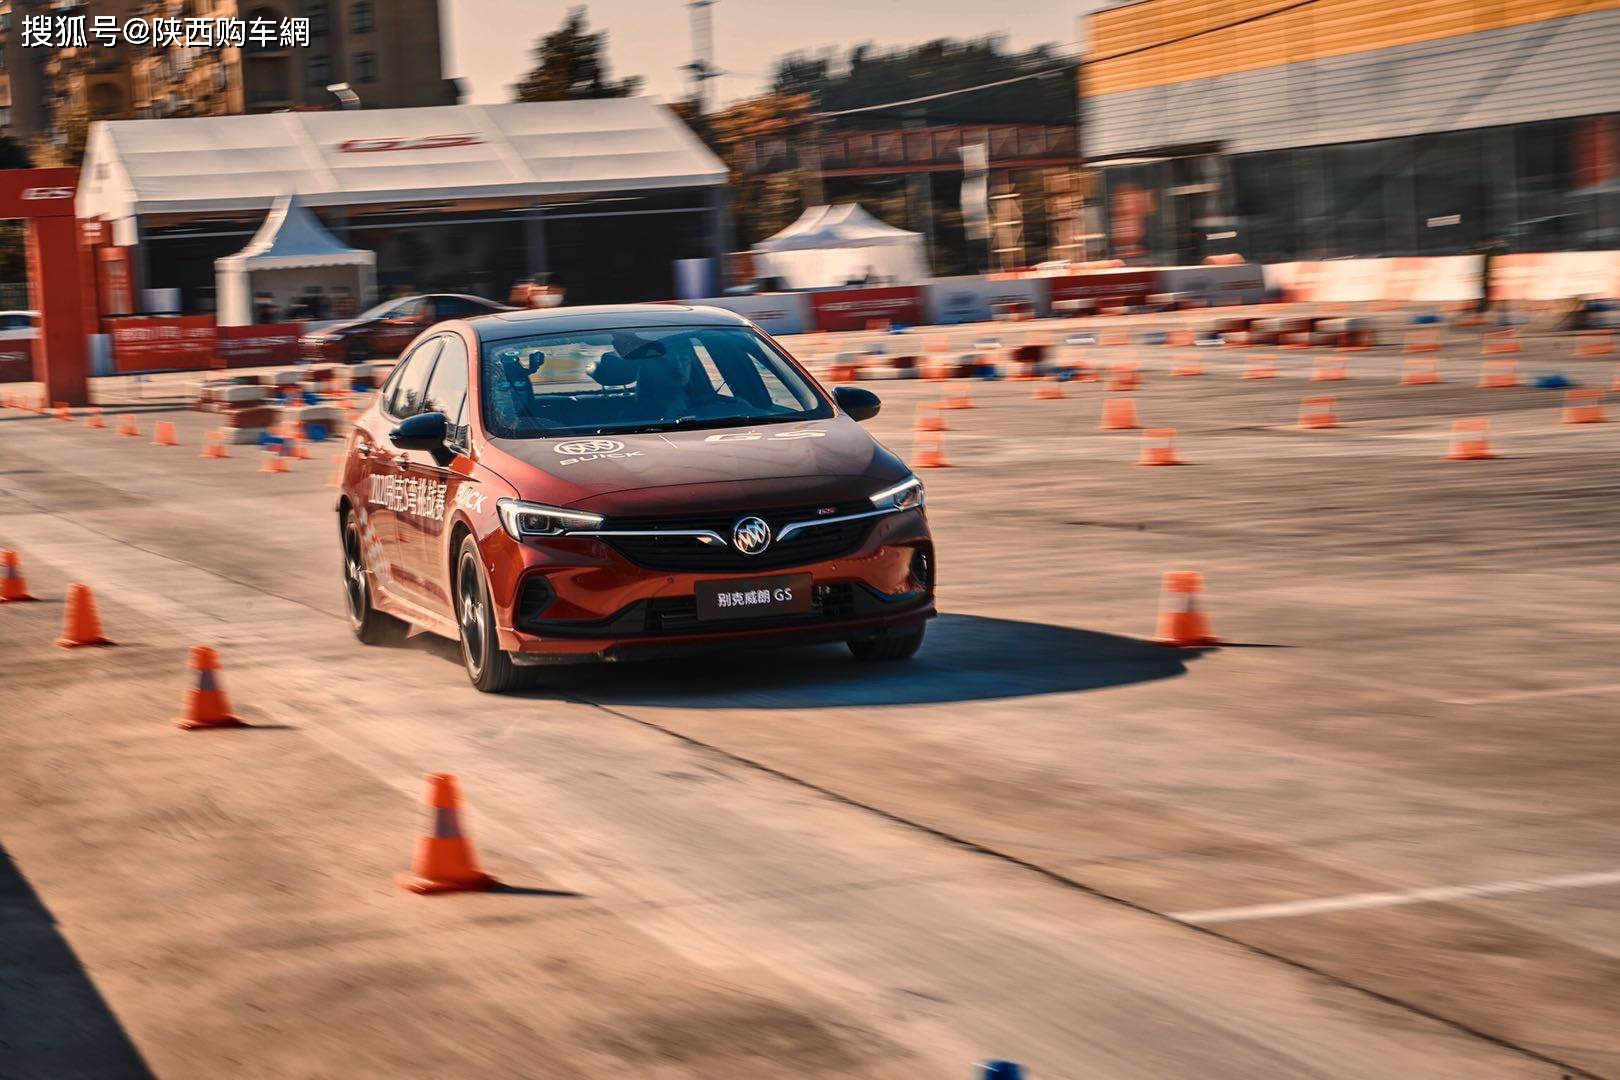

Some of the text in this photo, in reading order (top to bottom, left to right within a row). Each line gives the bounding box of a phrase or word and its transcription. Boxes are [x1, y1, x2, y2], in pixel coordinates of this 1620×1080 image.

[704, 429, 827, 442] GS
[559, 451, 646, 466] BUICK
[717, 587, 793, 608] 别克威朗 GS
